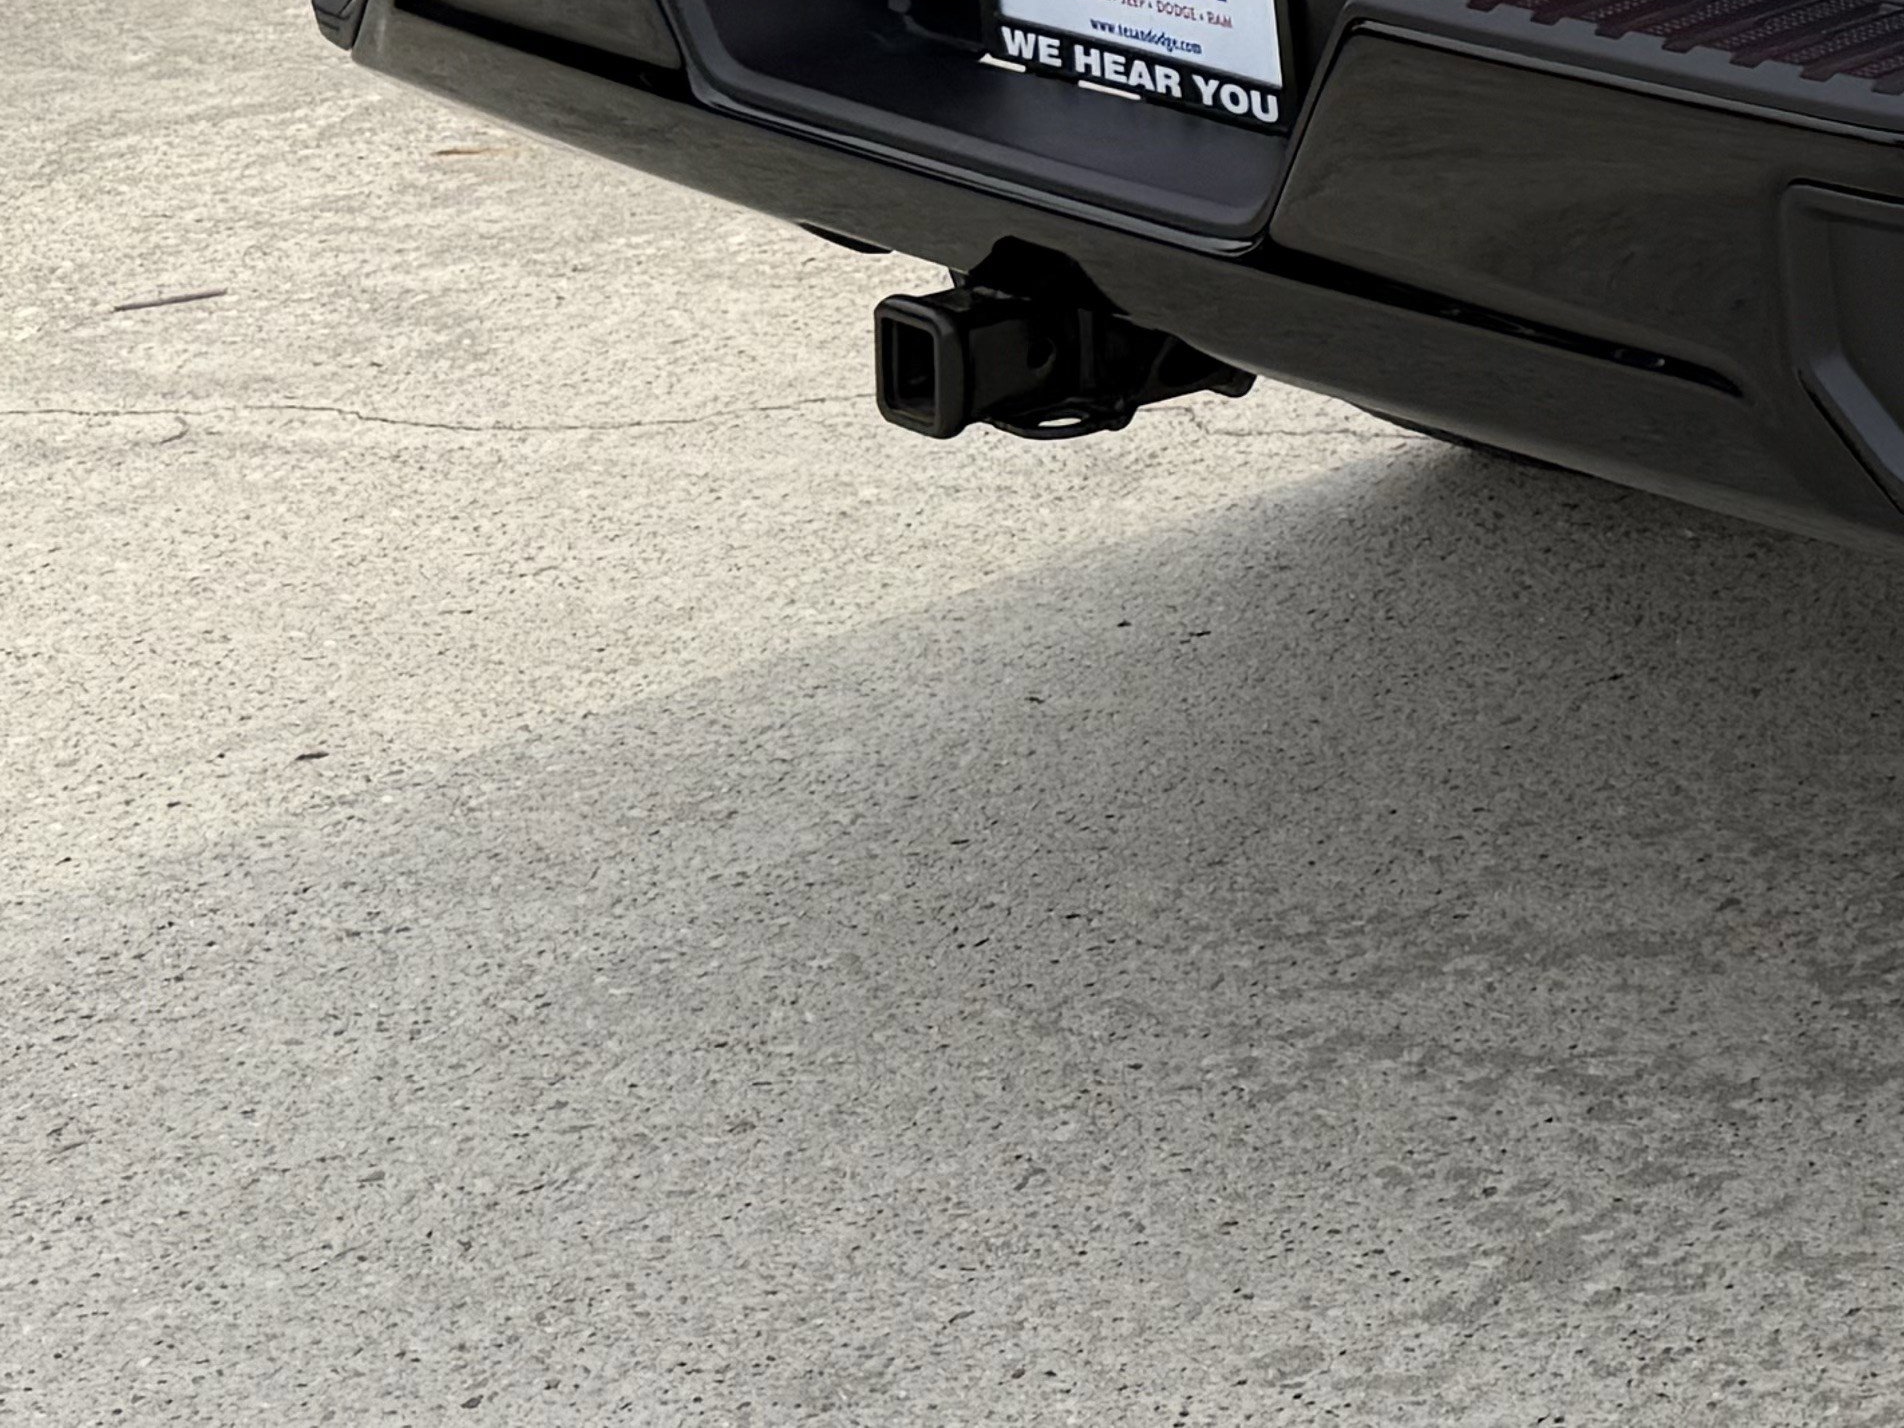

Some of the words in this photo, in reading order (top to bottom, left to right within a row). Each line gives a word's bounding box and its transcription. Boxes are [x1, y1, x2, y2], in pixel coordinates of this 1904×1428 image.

[1156, 0, 1197, 21] DODGE
[1206, 11, 1233, 28] RAM
[1001, 25, 1062, 67] WE
[1073, 43, 1182, 97] HEAR
[1192, 73, 1280, 123] YOU
